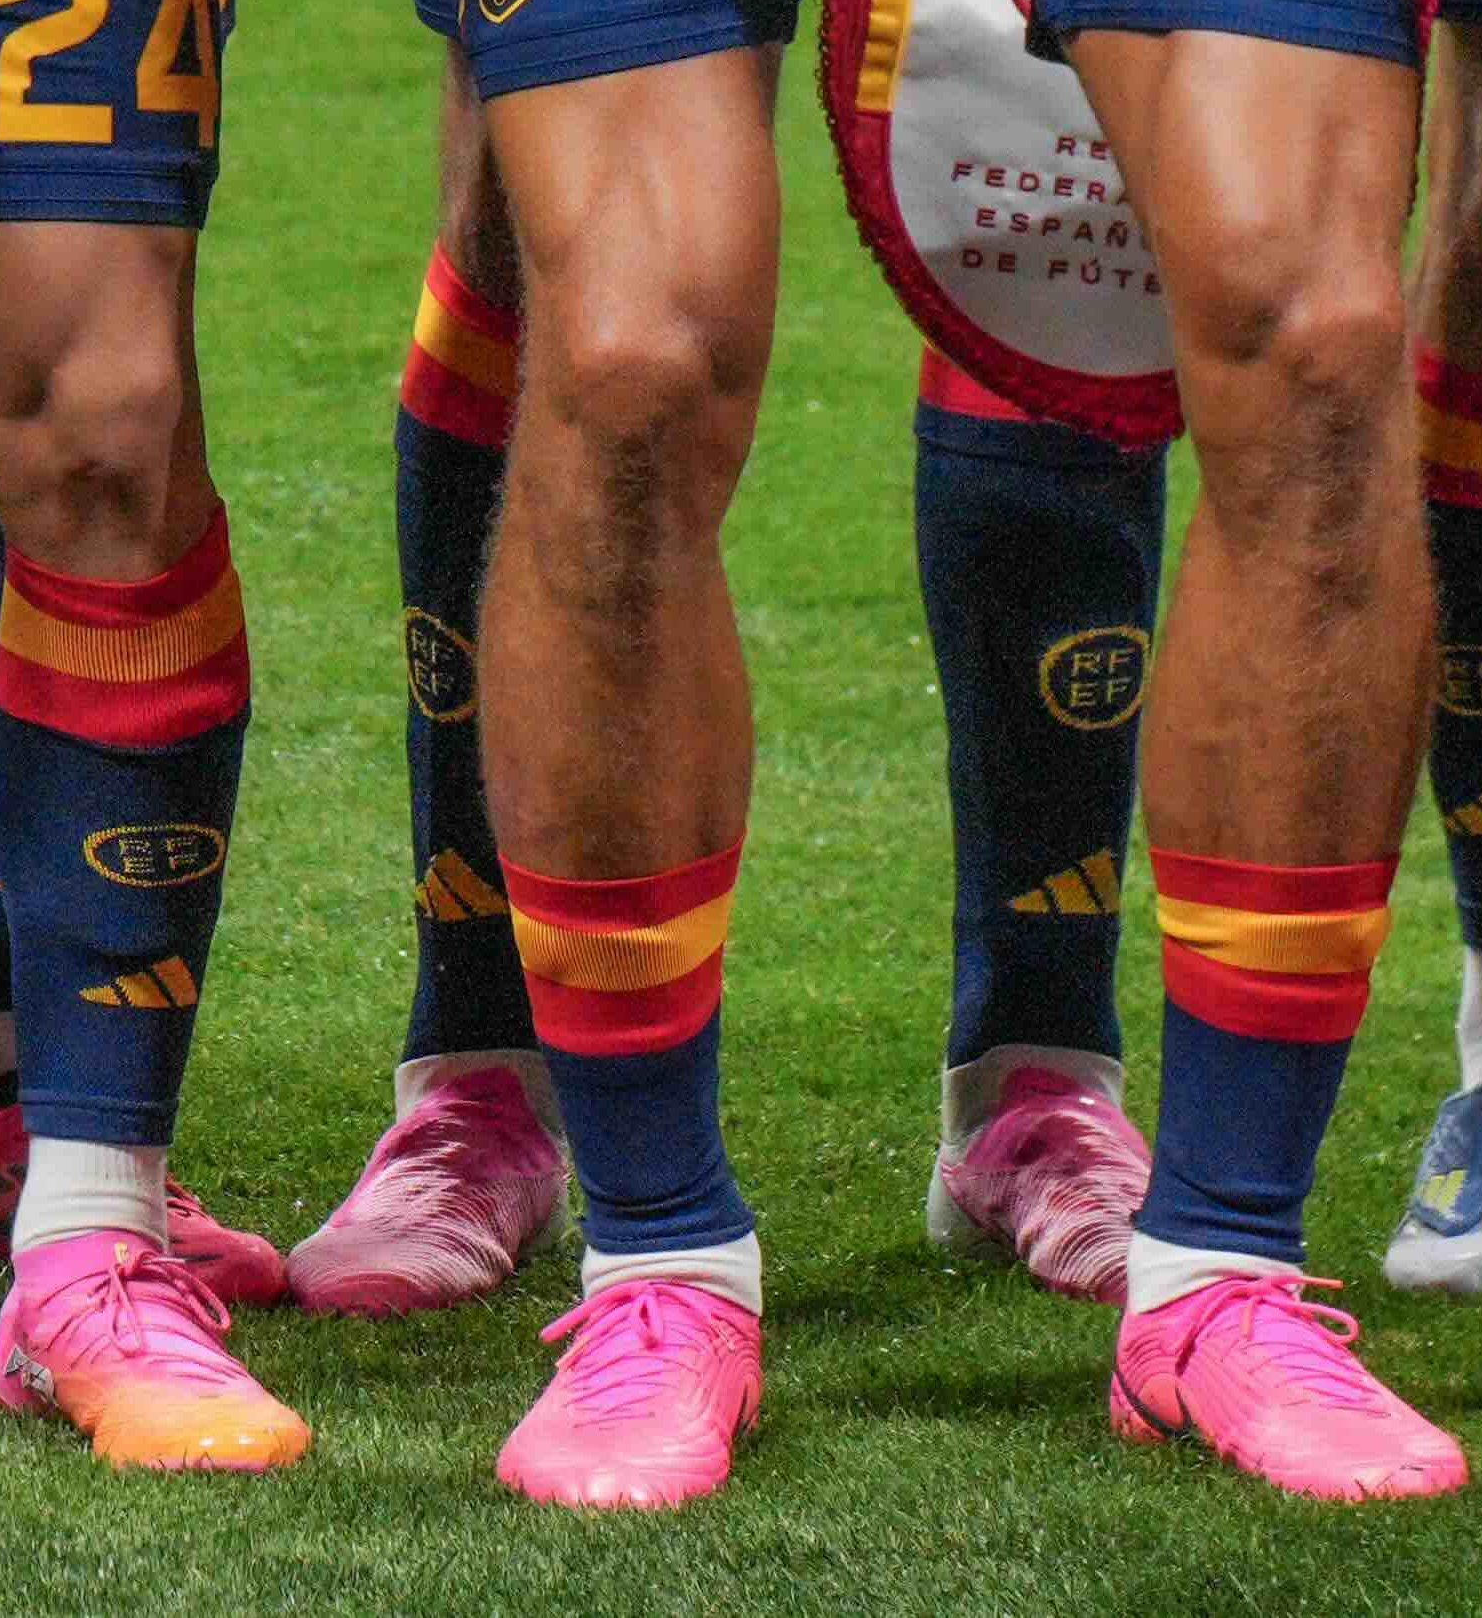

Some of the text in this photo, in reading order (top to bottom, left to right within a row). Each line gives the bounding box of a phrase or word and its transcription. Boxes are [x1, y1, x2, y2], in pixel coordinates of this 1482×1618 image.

[951, 162, 1130, 205] FEDER
[976, 209, 1149, 252] ESPAÑ
[963, 250, 1016, 273] DE
[1072, 647, 1131, 678] RF
[1071, 678, 1130, 706] EF
